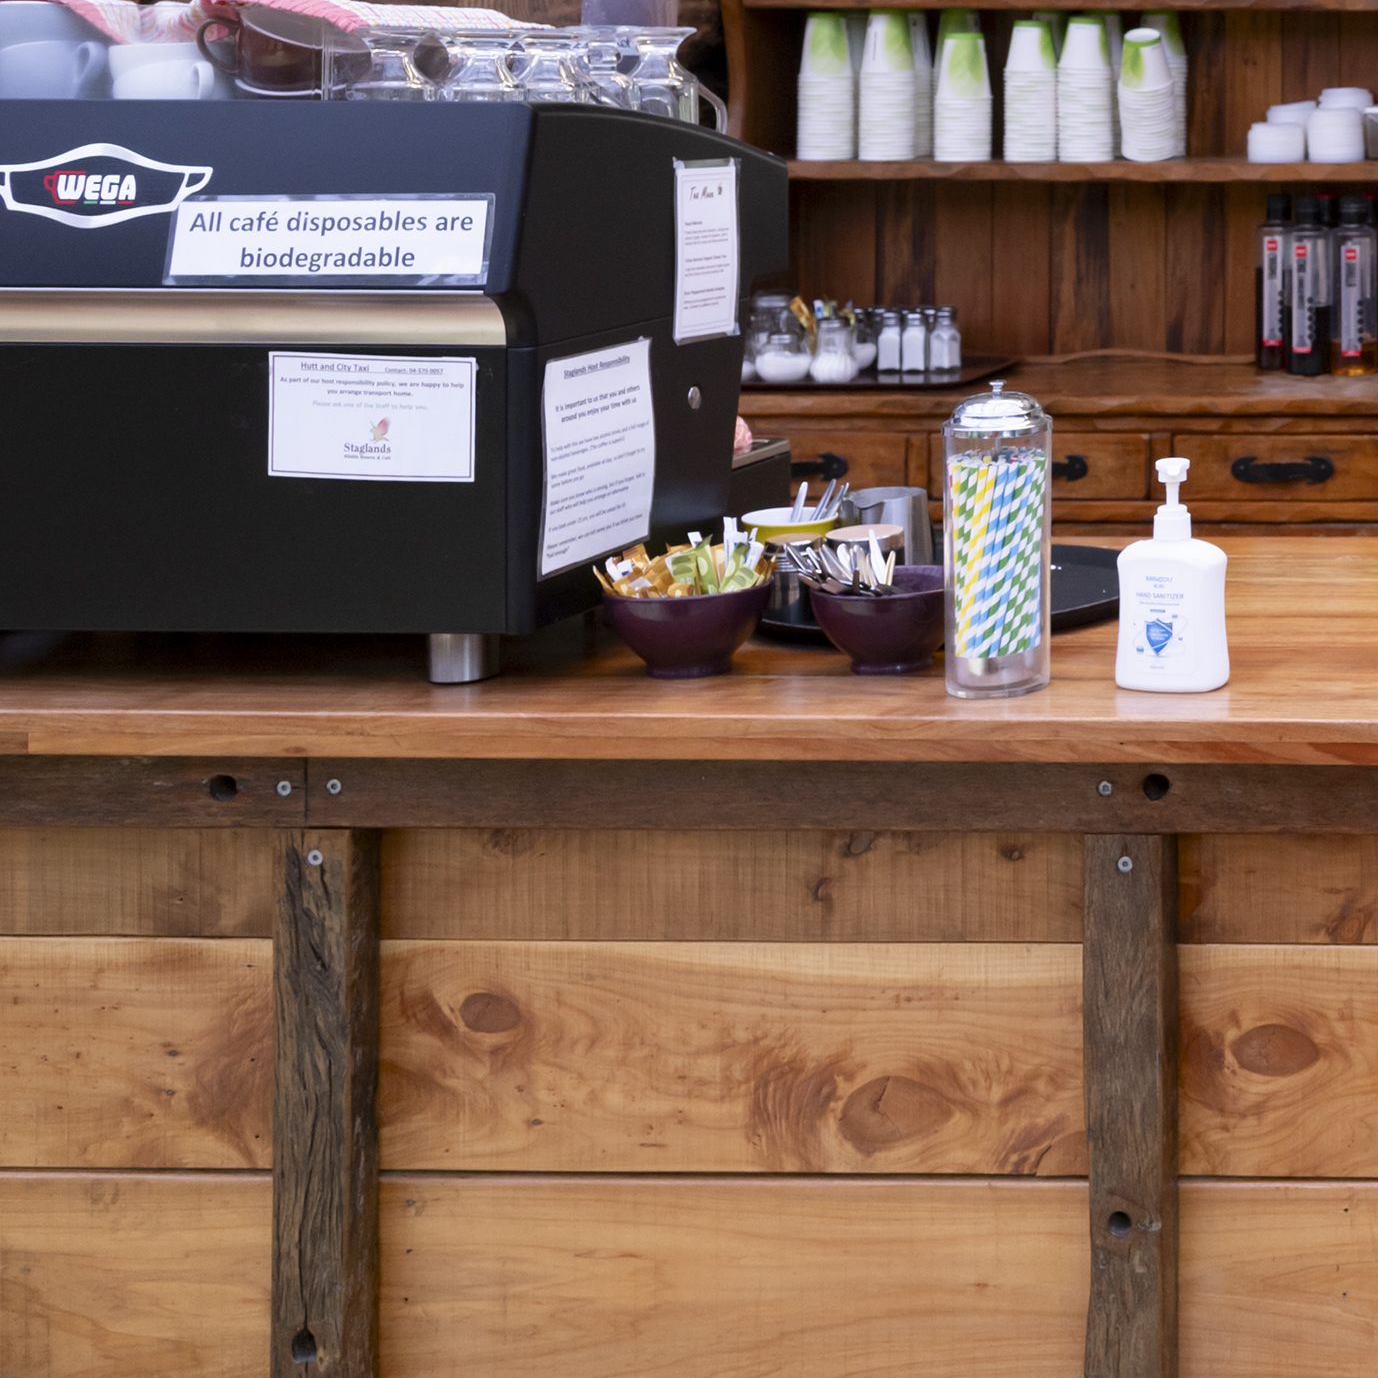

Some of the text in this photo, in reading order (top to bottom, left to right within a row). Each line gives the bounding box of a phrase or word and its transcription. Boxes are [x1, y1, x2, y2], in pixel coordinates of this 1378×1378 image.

[56, 173, 137, 201] WEGA
[189, 210, 474, 236] All café disposables are
[240, 247, 415, 272] biodegradable
[301, 362, 369, 372] Hutt and City Taxi
[588, 363, 598, 371] Host
[336, 379, 375, 387] responsibility
[421, 381, 441, 389] happy
[565, 398, 587, 410] important
[609, 391, 617, 400] you
[344, 442, 391, 454] Staglands
